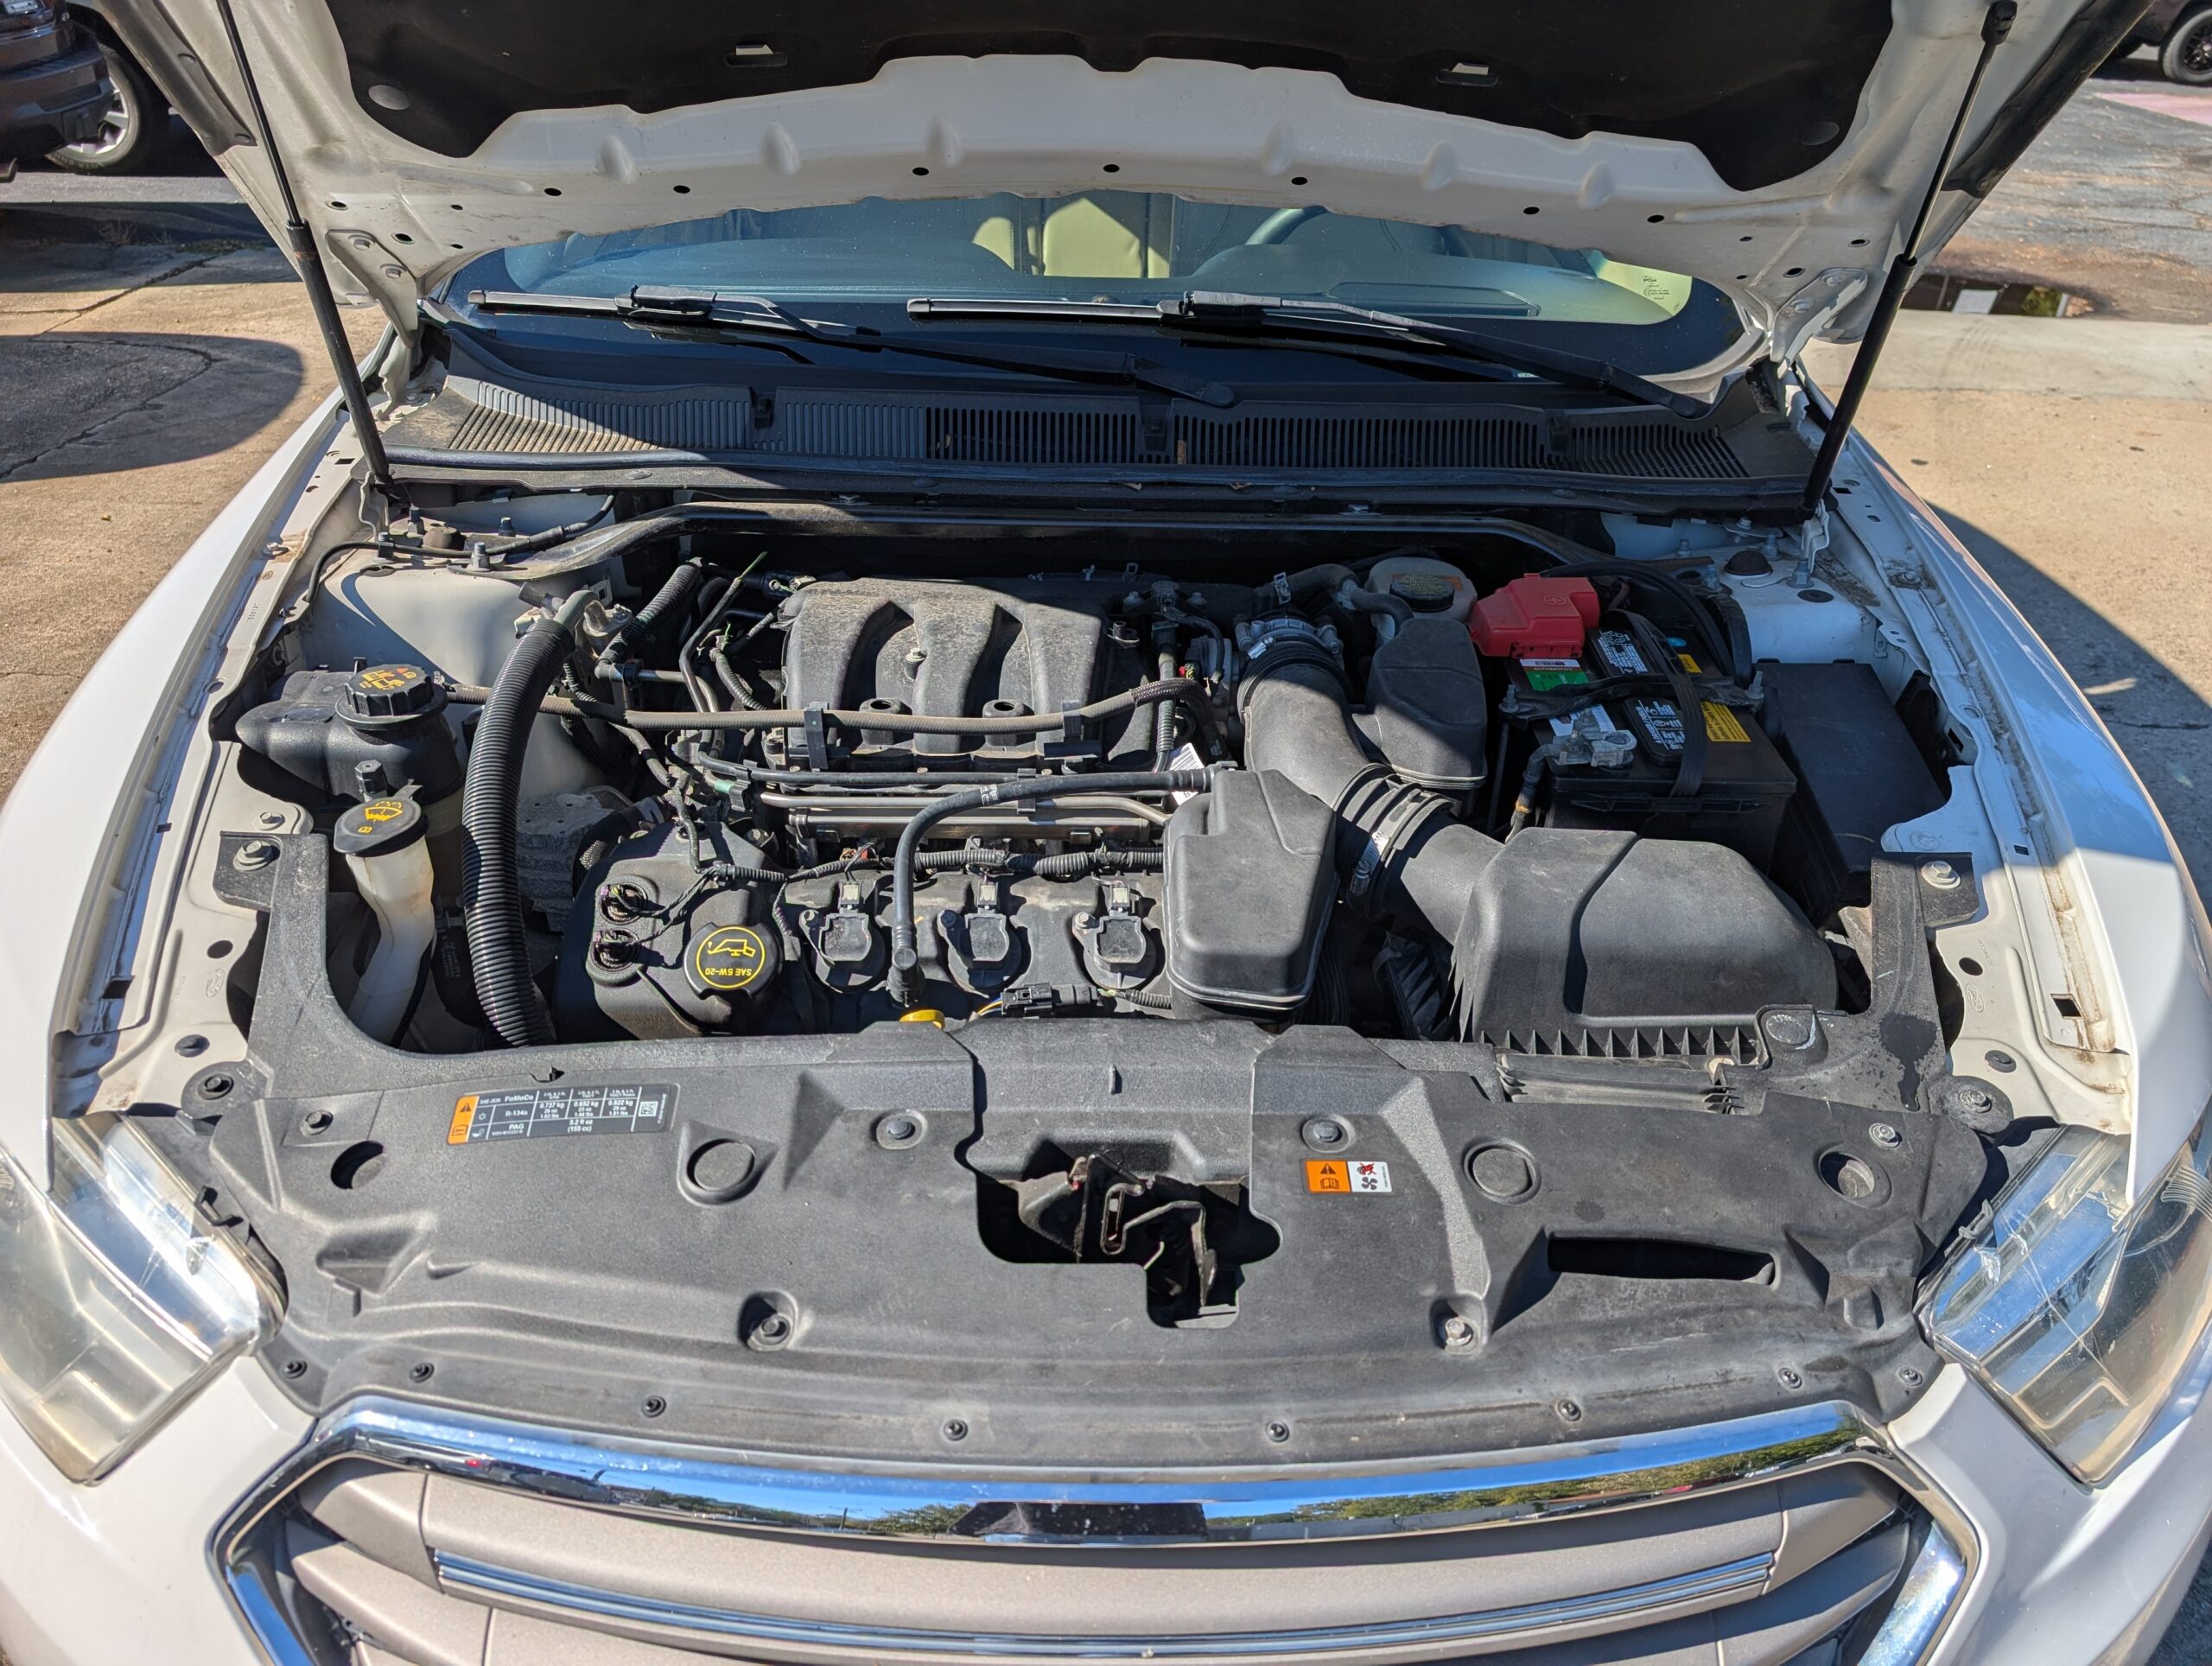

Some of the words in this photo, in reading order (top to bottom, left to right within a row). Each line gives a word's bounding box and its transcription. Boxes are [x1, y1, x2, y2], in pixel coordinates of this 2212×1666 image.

[704, 968, 734, 976] 5W-20
[735, 968, 753, 976] SAE
[504, 1094, 534, 1103] FoMoCo
[505, 1110, 529, 1118] R-134a
